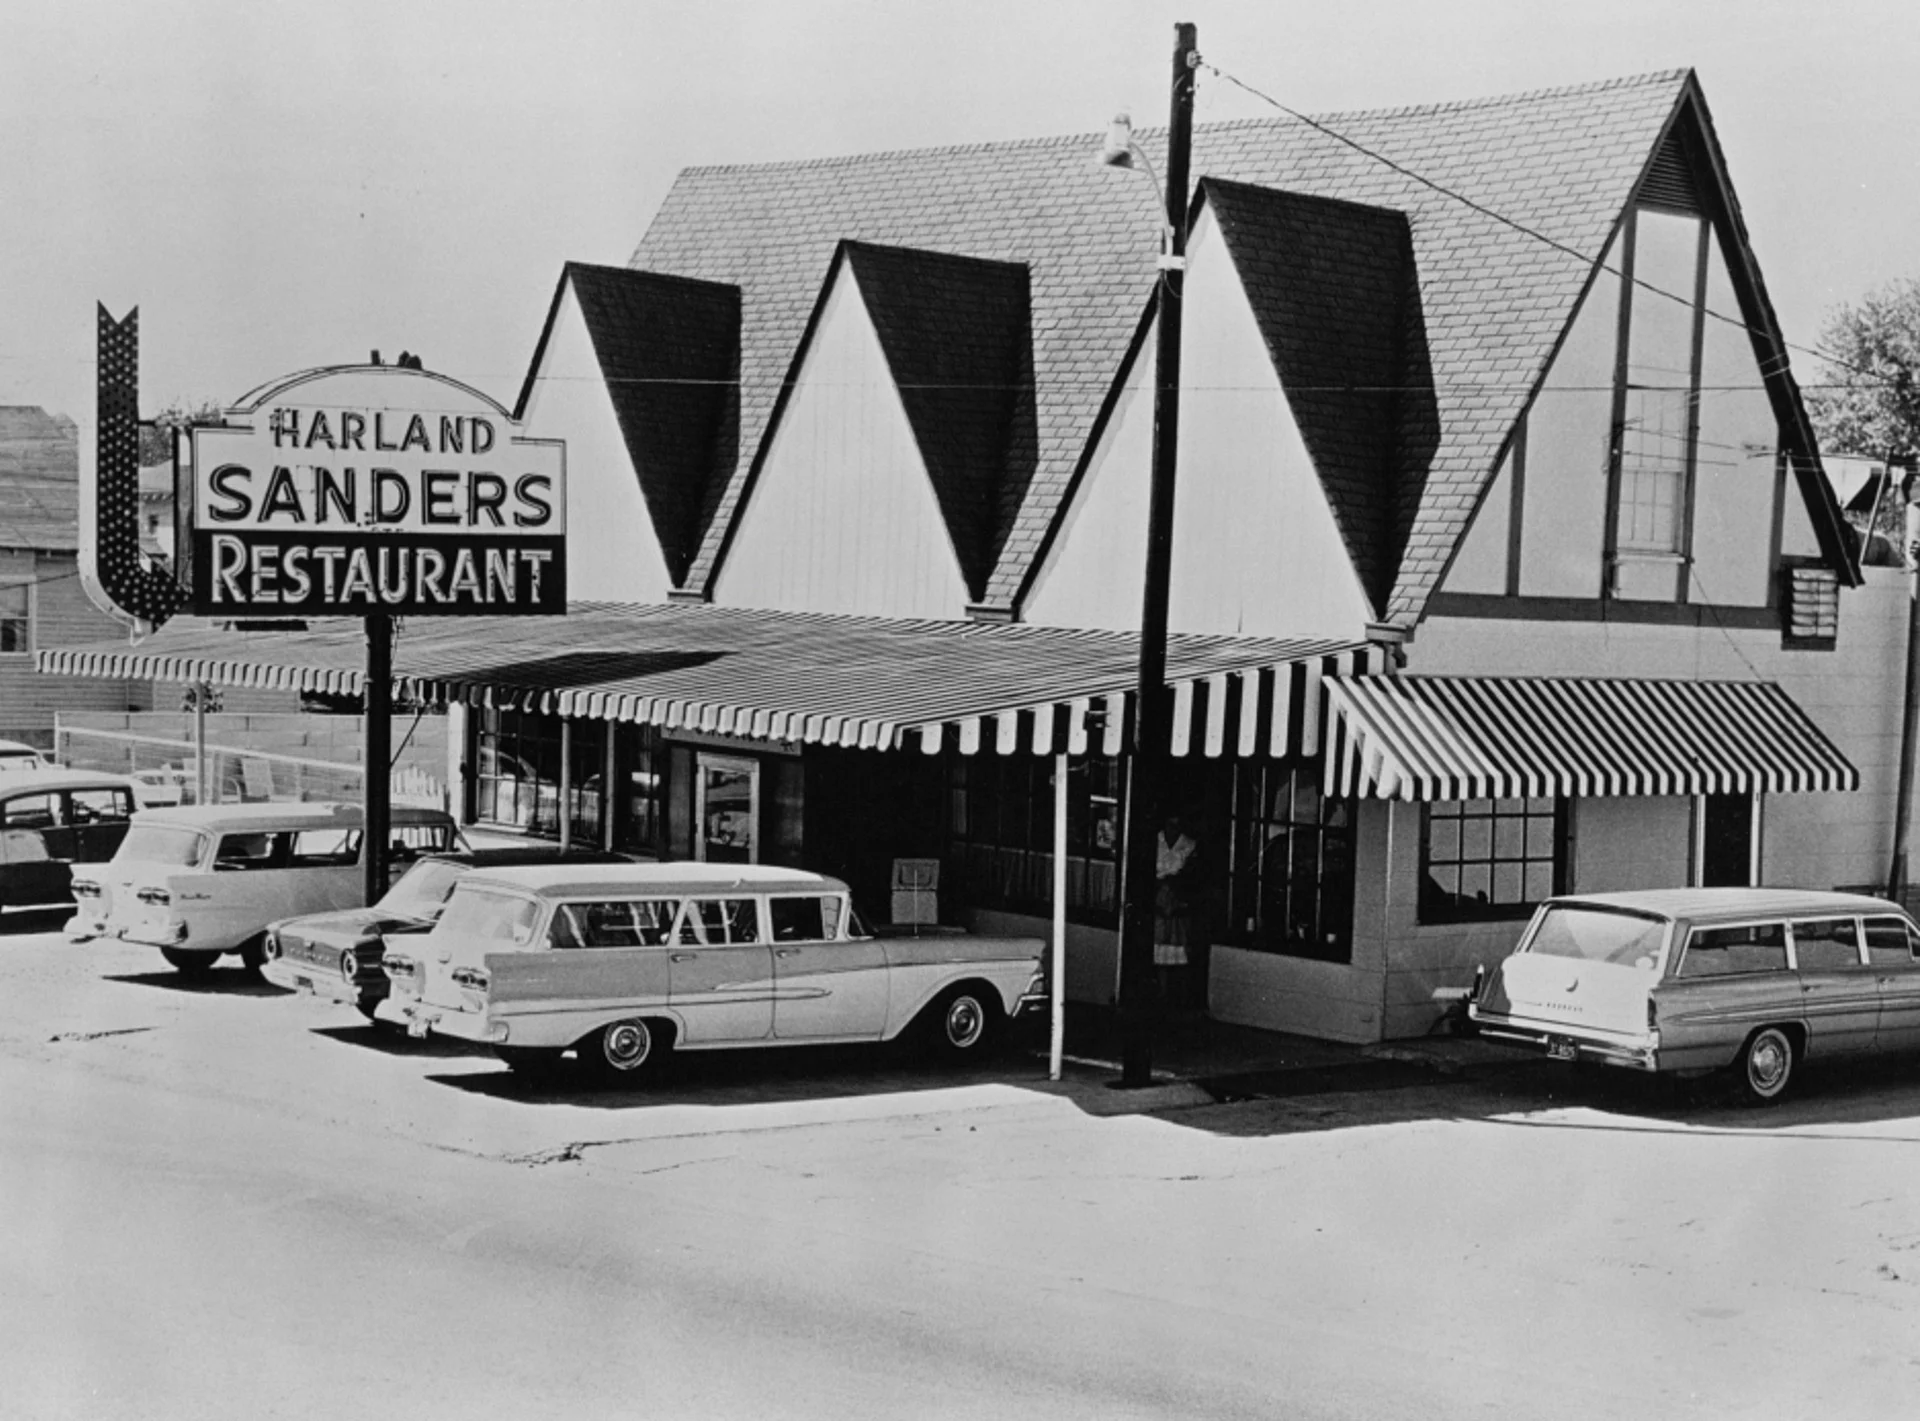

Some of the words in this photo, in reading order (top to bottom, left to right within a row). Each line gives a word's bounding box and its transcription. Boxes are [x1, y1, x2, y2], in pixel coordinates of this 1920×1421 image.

[270, 408, 495, 453] HARLAND
[208, 463, 553, 527] SANDERS
[211, 534, 552, 603] RESTAURANT
